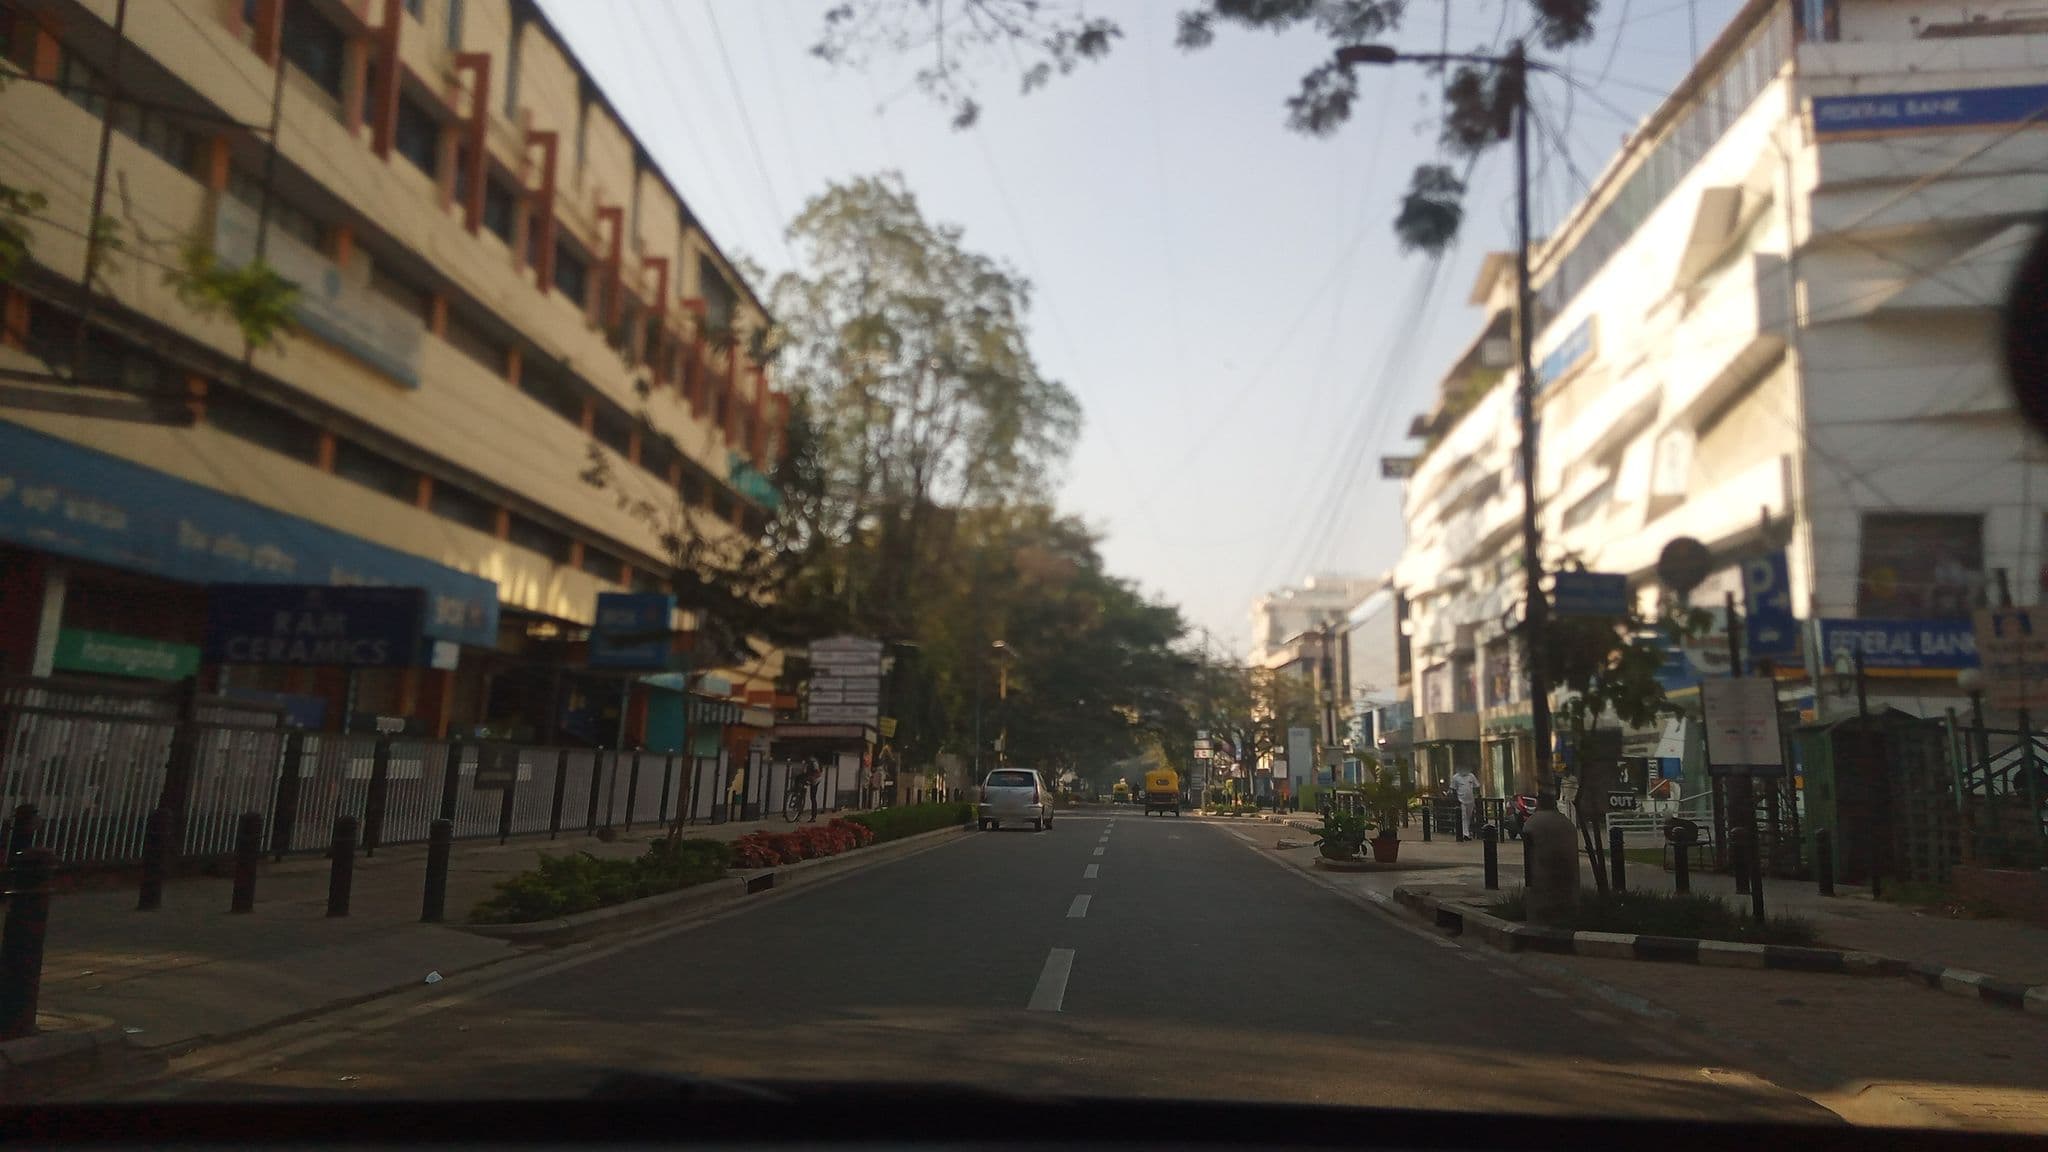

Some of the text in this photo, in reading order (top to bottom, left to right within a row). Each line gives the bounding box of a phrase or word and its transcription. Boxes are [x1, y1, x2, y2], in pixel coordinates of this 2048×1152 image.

[1904, 97, 1963, 116] BANK
[273, 611, 347, 635] RAM
[225, 636, 389, 664] CERAMICS
[1609, 795, 1634, 808] OUT
